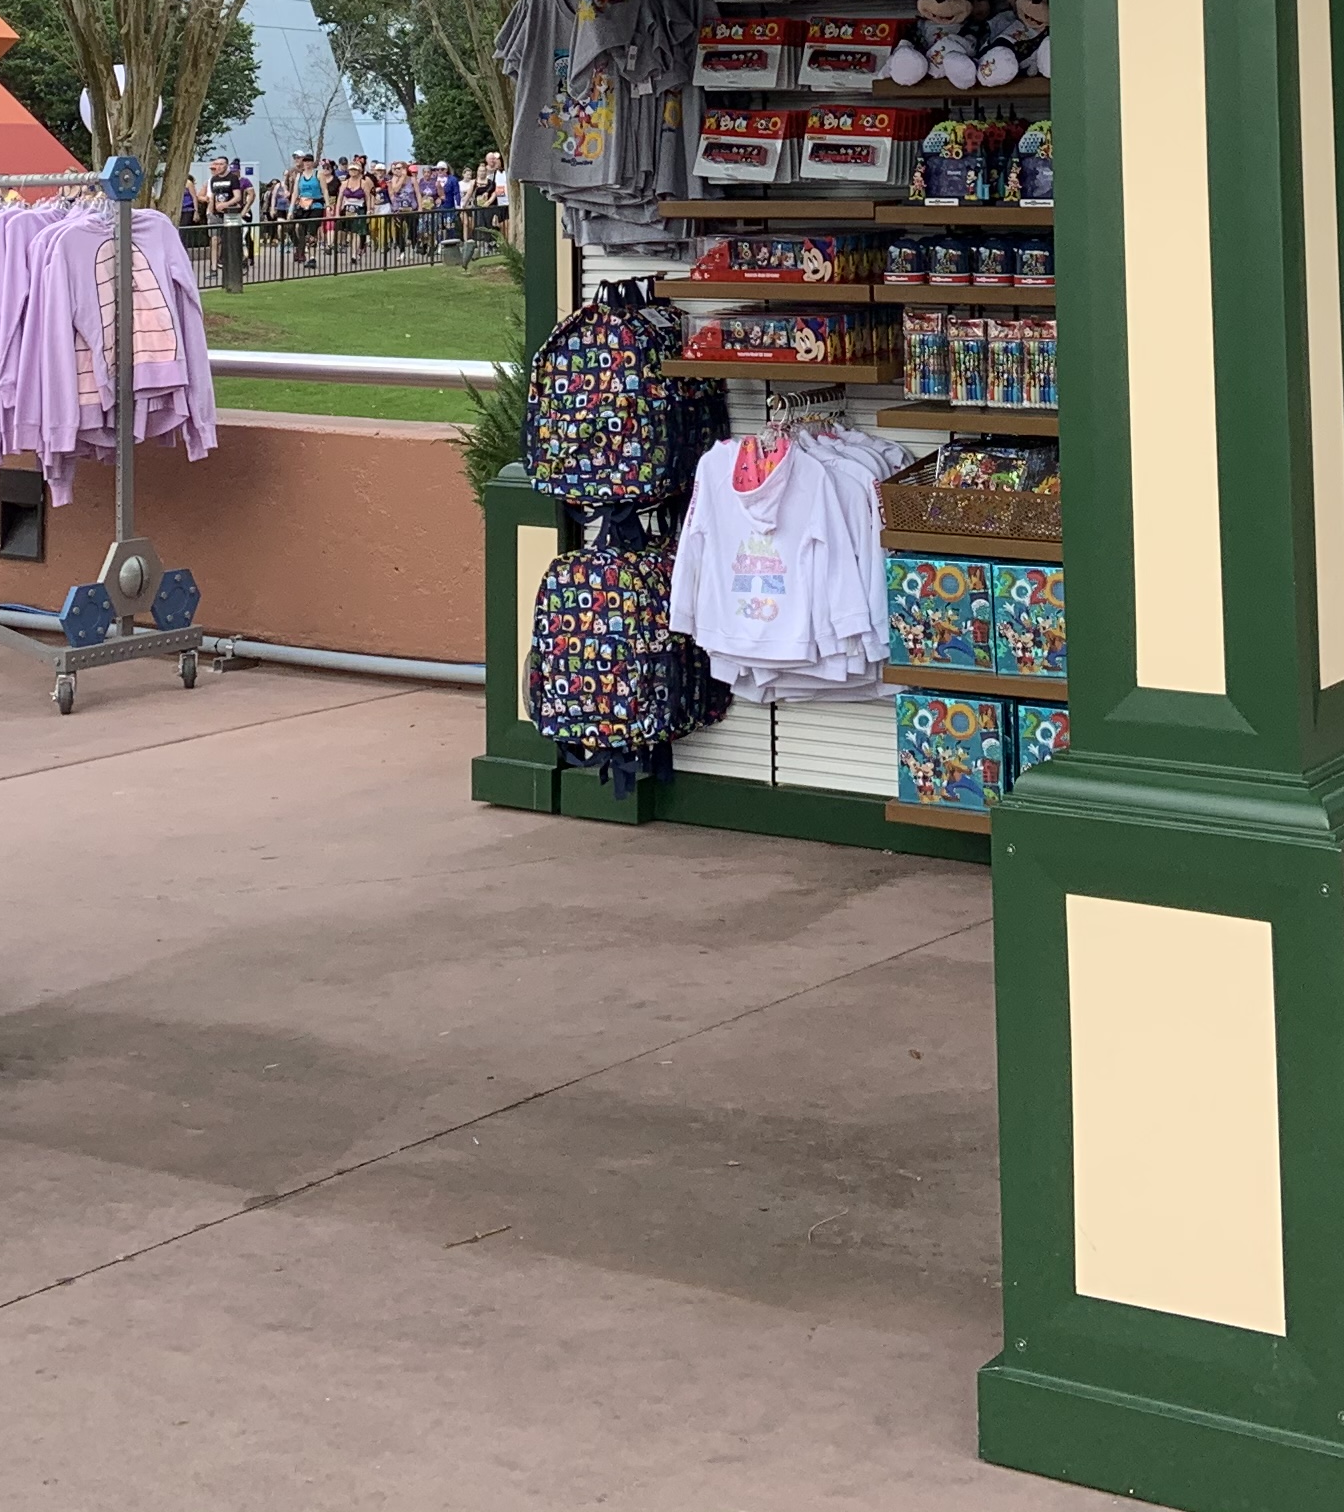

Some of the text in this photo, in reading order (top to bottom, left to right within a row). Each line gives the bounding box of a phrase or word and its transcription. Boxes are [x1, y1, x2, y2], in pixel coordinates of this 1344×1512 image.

[551, 129, 604, 160] 2020
[562, 588, 621, 611] 2020
[887, 563, 967, 602] 2020
[735, 597, 779, 622] 2020
[900, 699, 978, 741] 2020
[1022, 711, 1070, 750] 202
